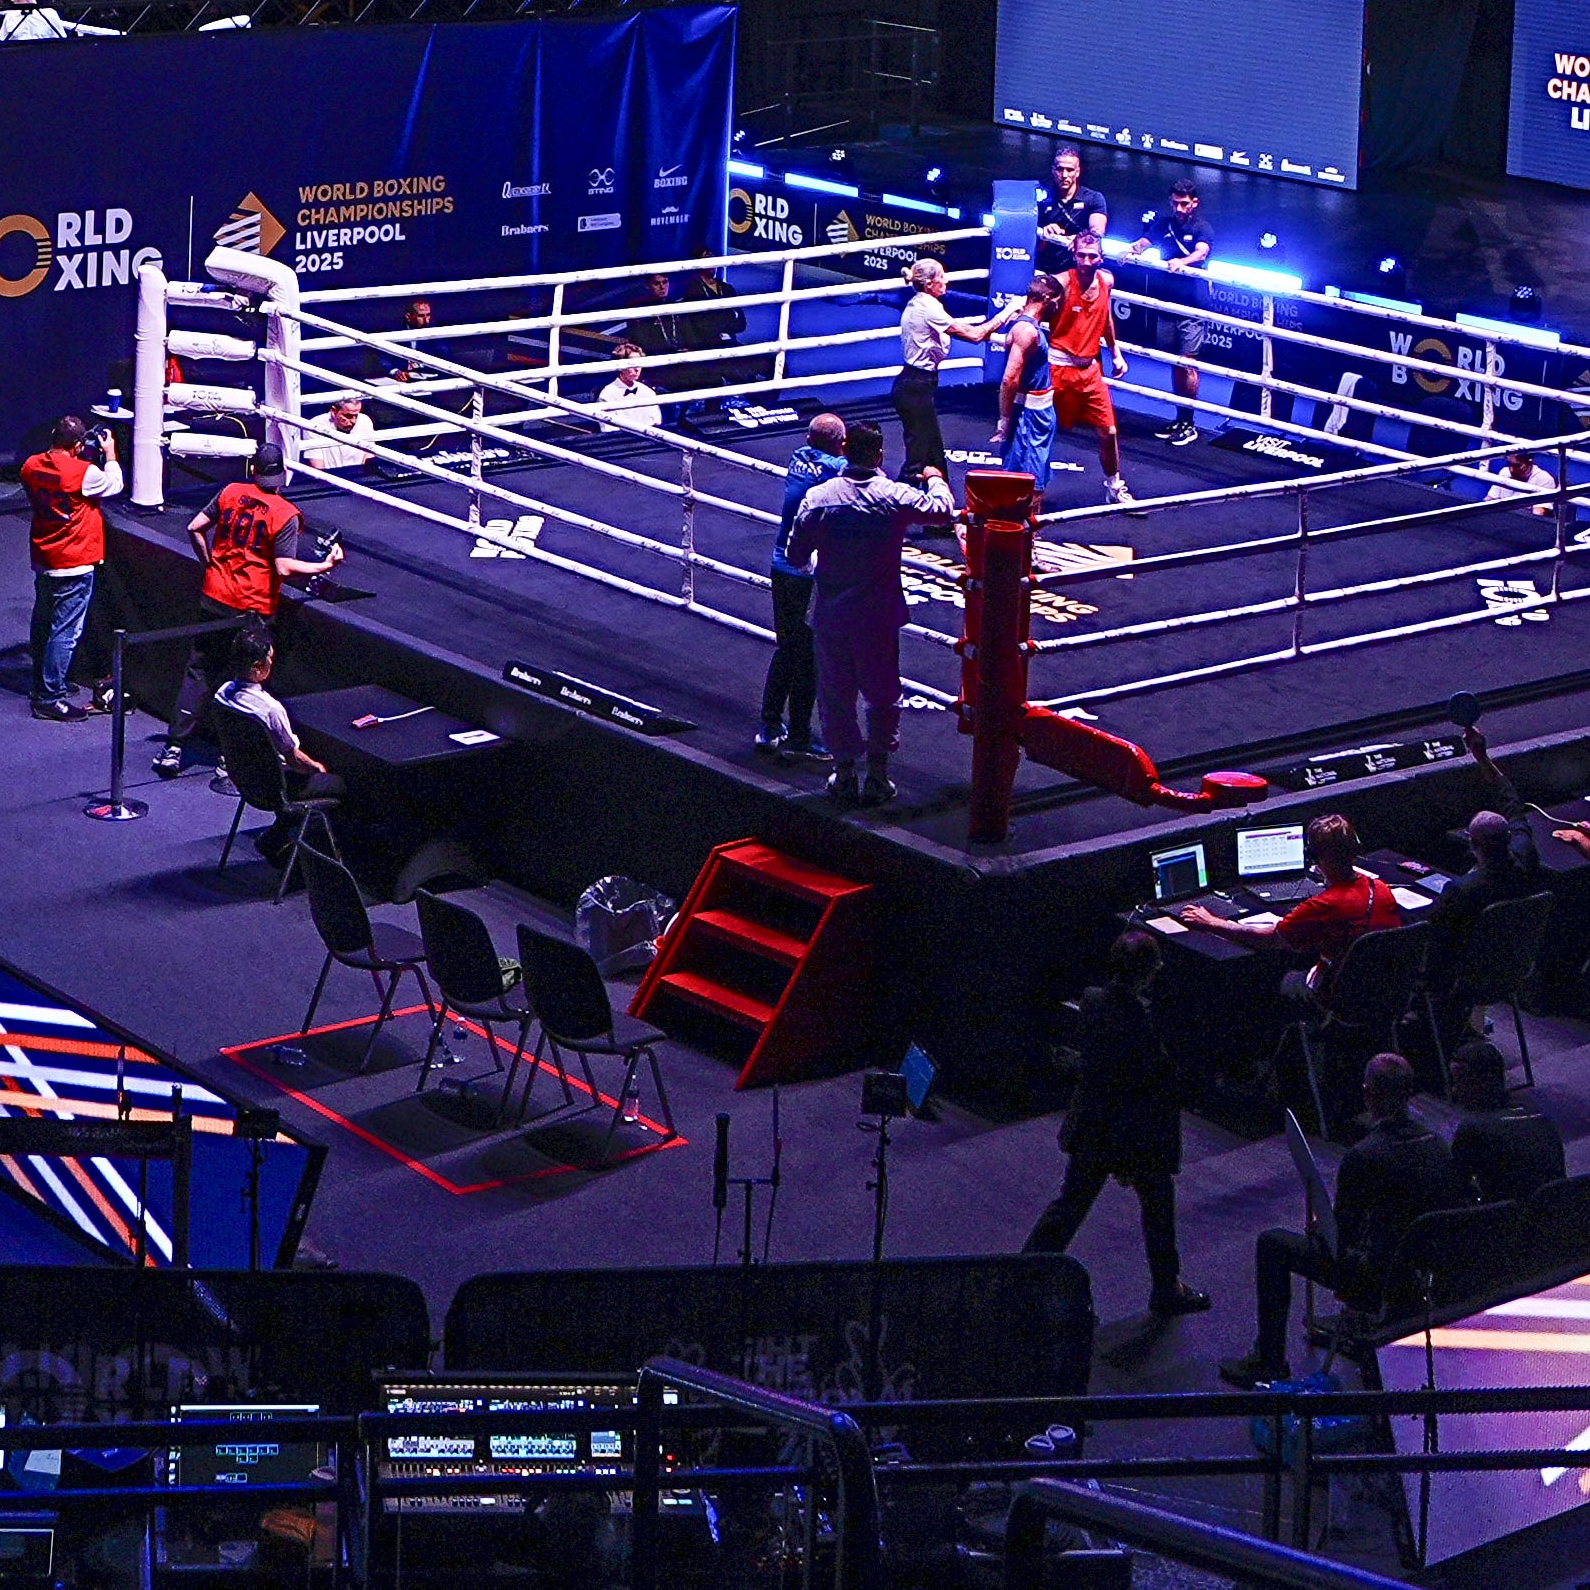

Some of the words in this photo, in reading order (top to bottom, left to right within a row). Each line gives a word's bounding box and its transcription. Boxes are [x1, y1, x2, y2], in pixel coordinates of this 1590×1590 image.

[299, 181, 369, 203] WORLD
[373, 175, 446, 198] BOXING
[296, 196, 455, 227] CHAMPIONSHIPS
[865, 213, 901, 231] WORLD
[295, 223, 406, 250] LIVERPOOL
[295, 252, 344, 273] 2025
[863, 255, 888, 270] 2025
